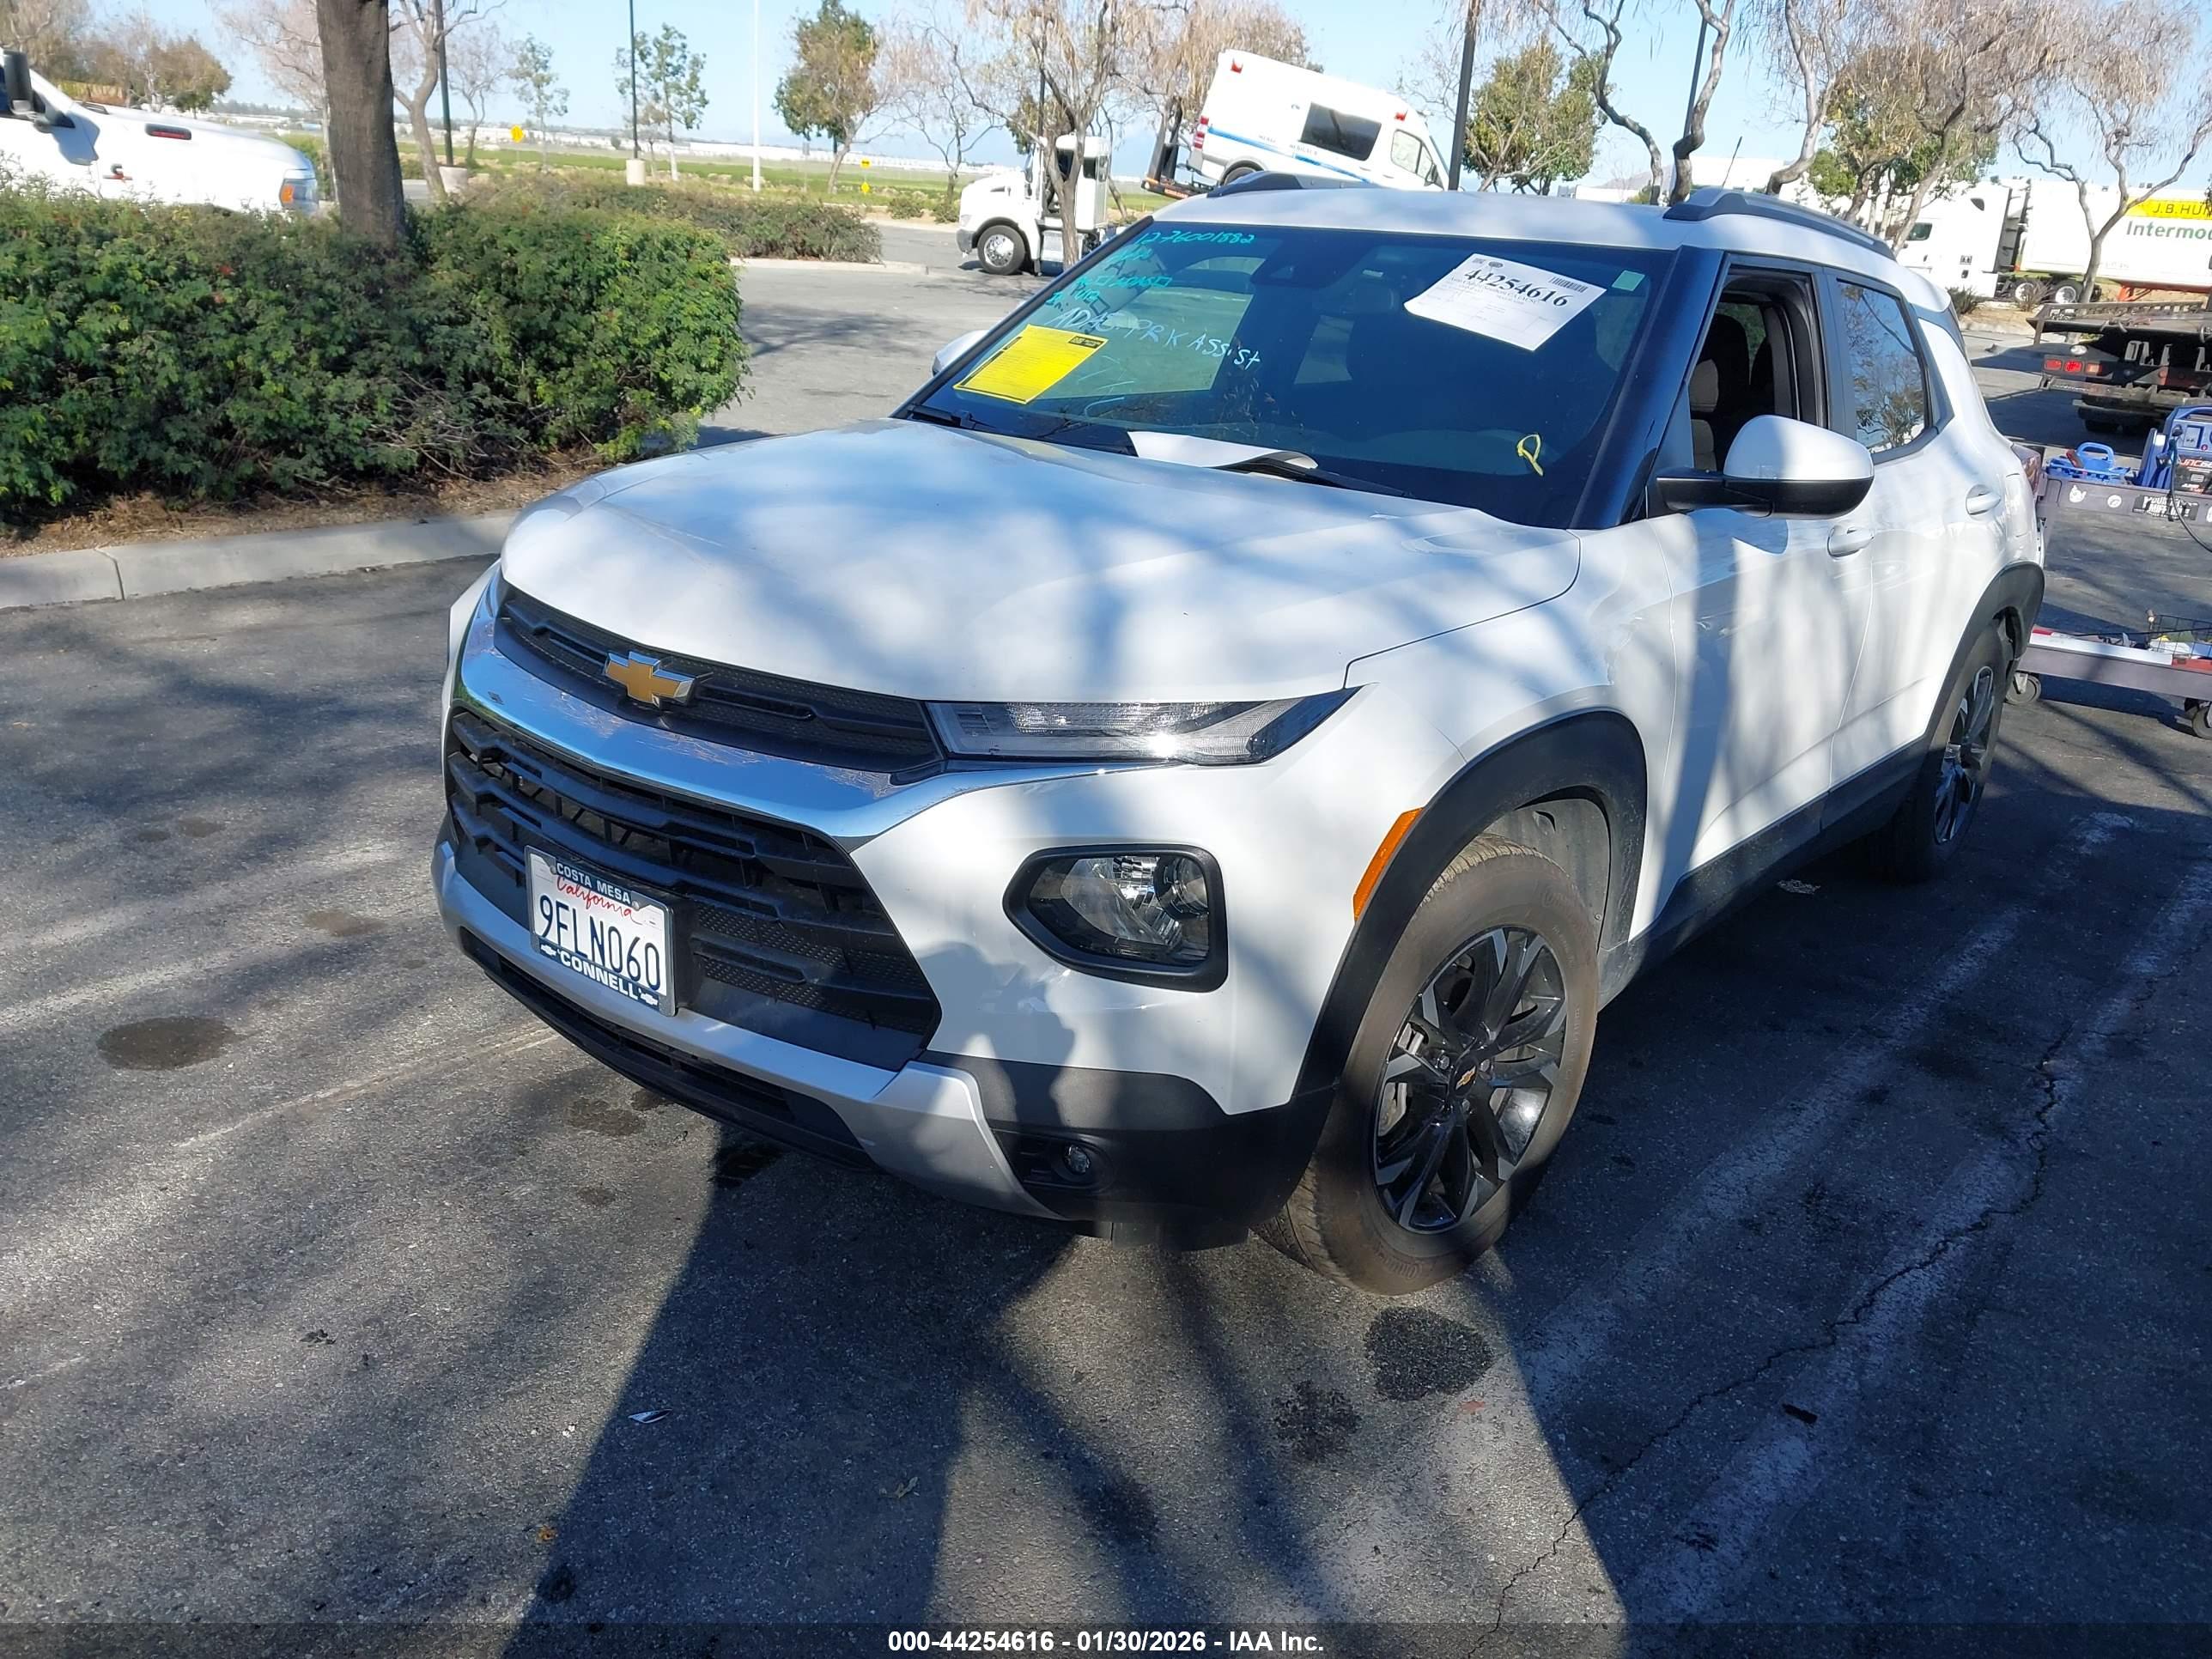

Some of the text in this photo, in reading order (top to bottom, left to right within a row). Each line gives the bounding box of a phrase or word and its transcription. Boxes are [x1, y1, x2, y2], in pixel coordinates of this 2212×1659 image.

[1465, 269, 1574, 307] 44254616
[556, 862, 631, 903] COSTA MESA
[556, 875, 641, 925] California
[539, 895, 661, 991] 9FLN060
